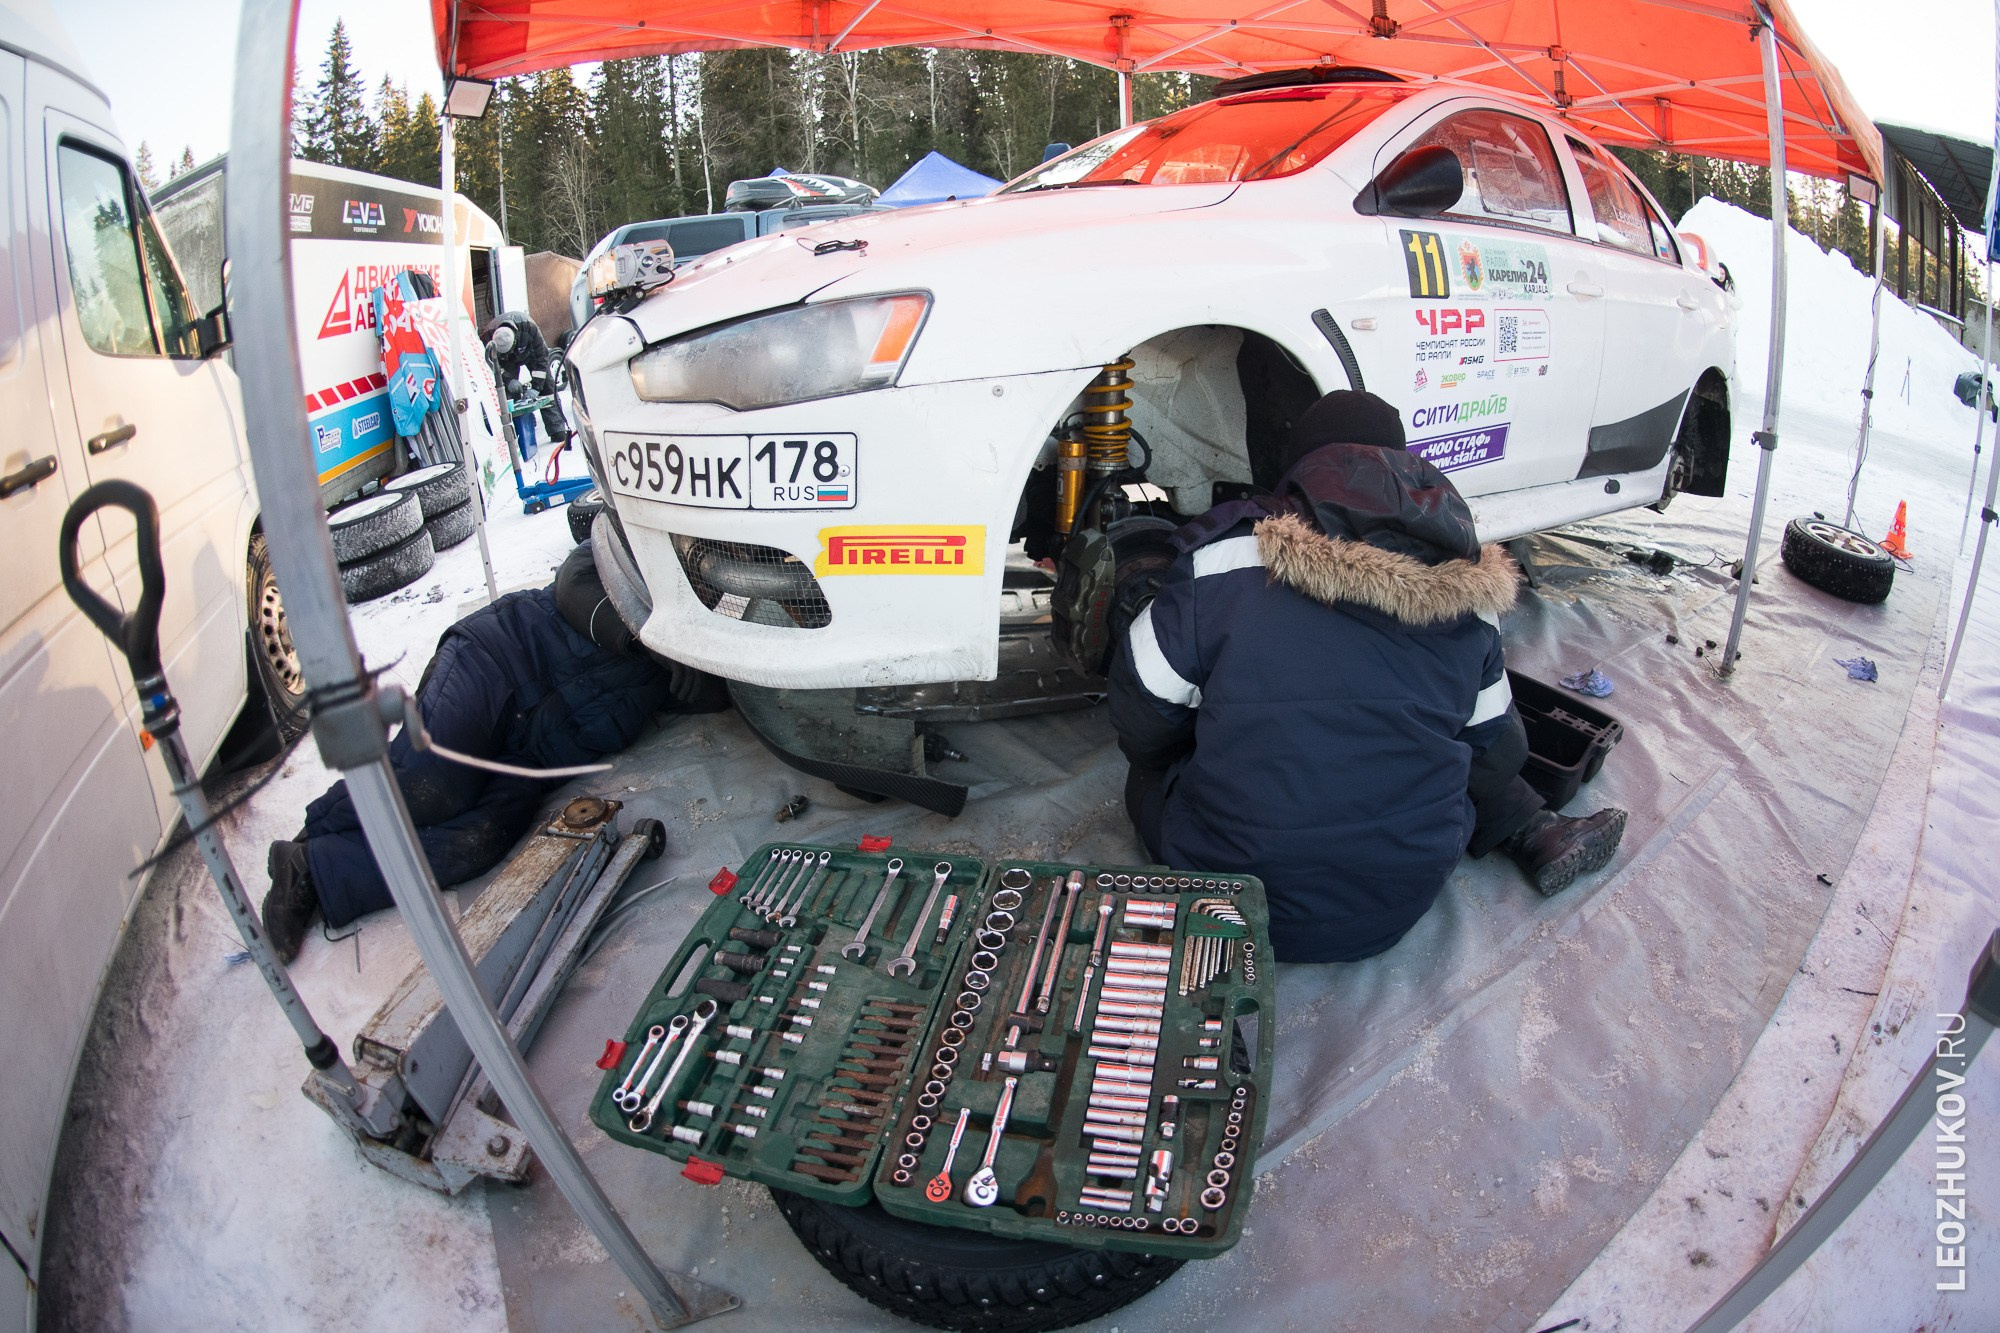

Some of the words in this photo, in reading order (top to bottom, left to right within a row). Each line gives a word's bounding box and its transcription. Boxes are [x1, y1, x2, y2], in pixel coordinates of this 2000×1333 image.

[1408, 233, 1445, 296] 11
[1415, 309, 1485, 335] ЧРР
[1416, 340, 1458, 351] ЧЕМПИОНАТ
[1460, 339, 1486, 349] РОССИИ
[754, 441, 840, 484] 178
[773, 485, 815, 501] RUS
[828, 535, 967, 566] PIRELLI
